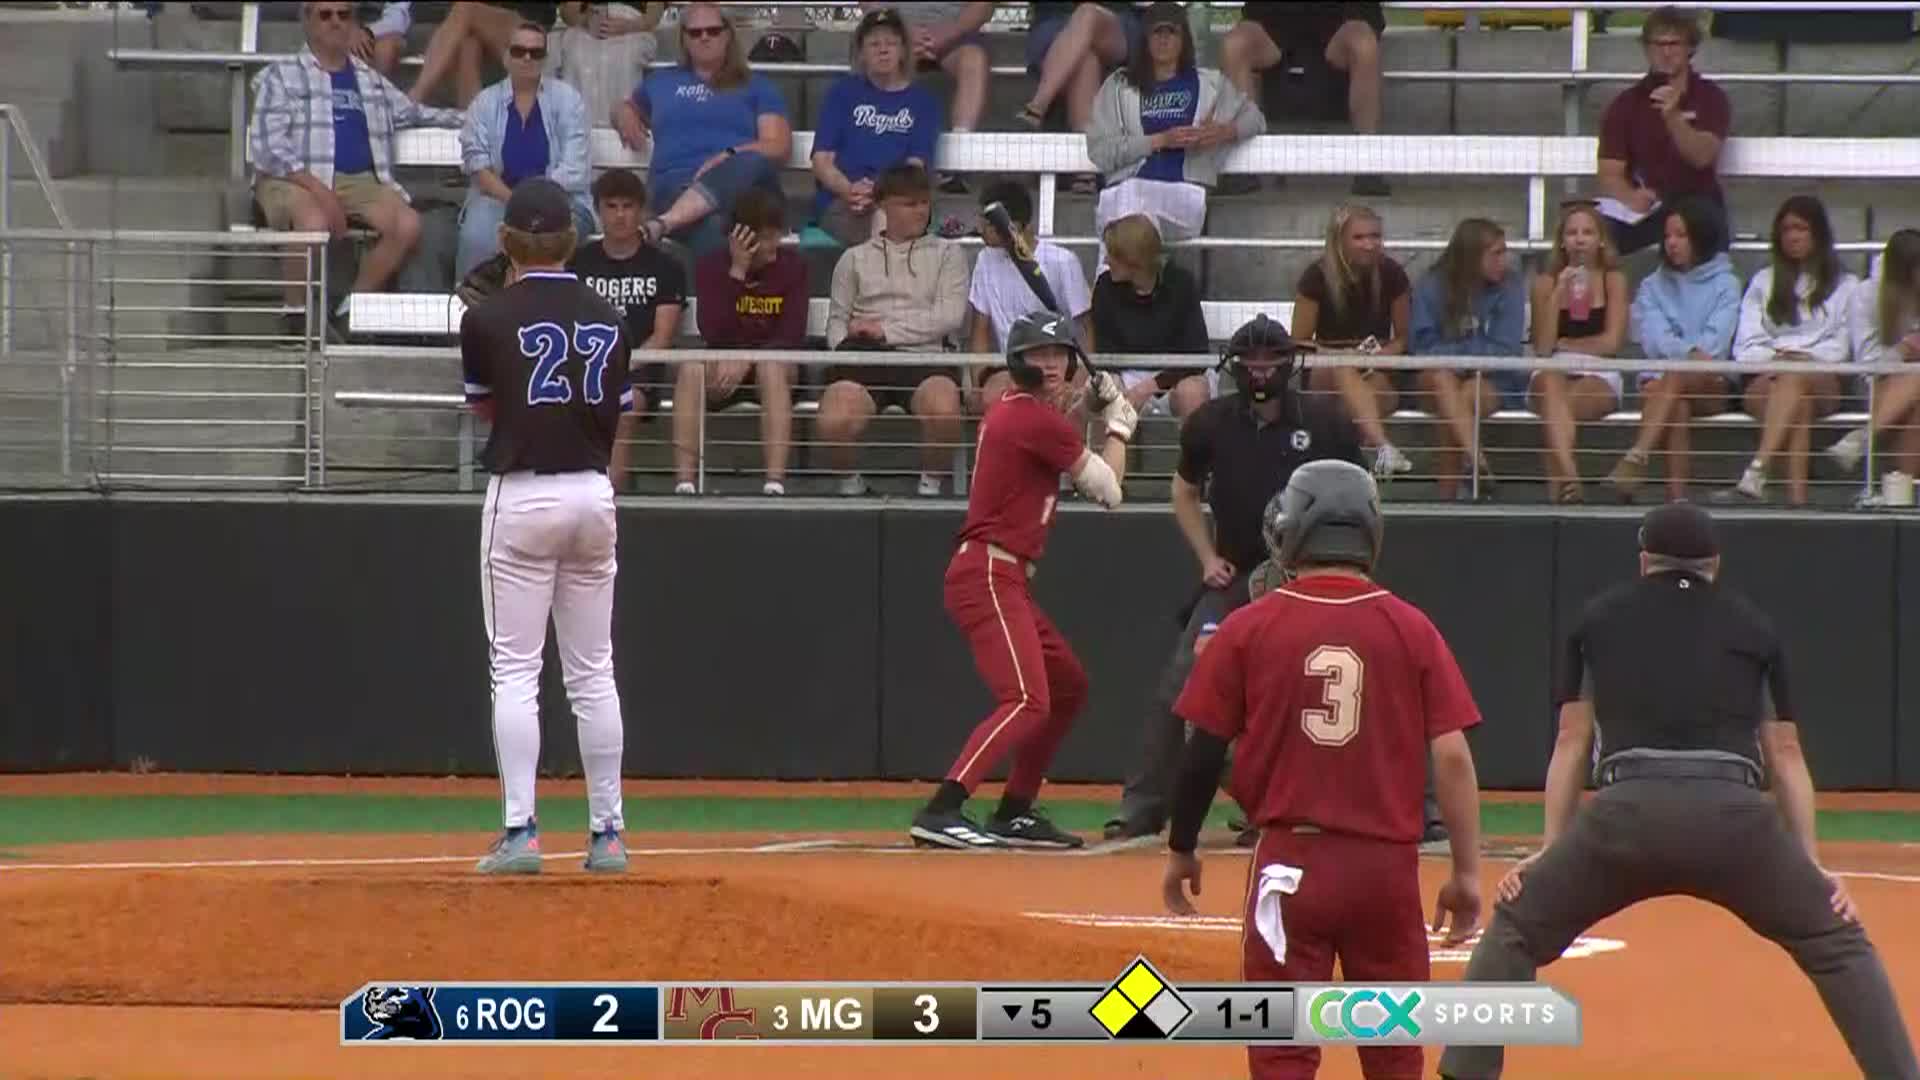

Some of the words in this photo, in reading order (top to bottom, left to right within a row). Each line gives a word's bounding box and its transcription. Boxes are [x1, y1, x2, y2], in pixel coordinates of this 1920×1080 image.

[853, 104, 914, 135] Royals
[518, 320, 619, 405] 27
[1301, 644, 1364, 746] 3
